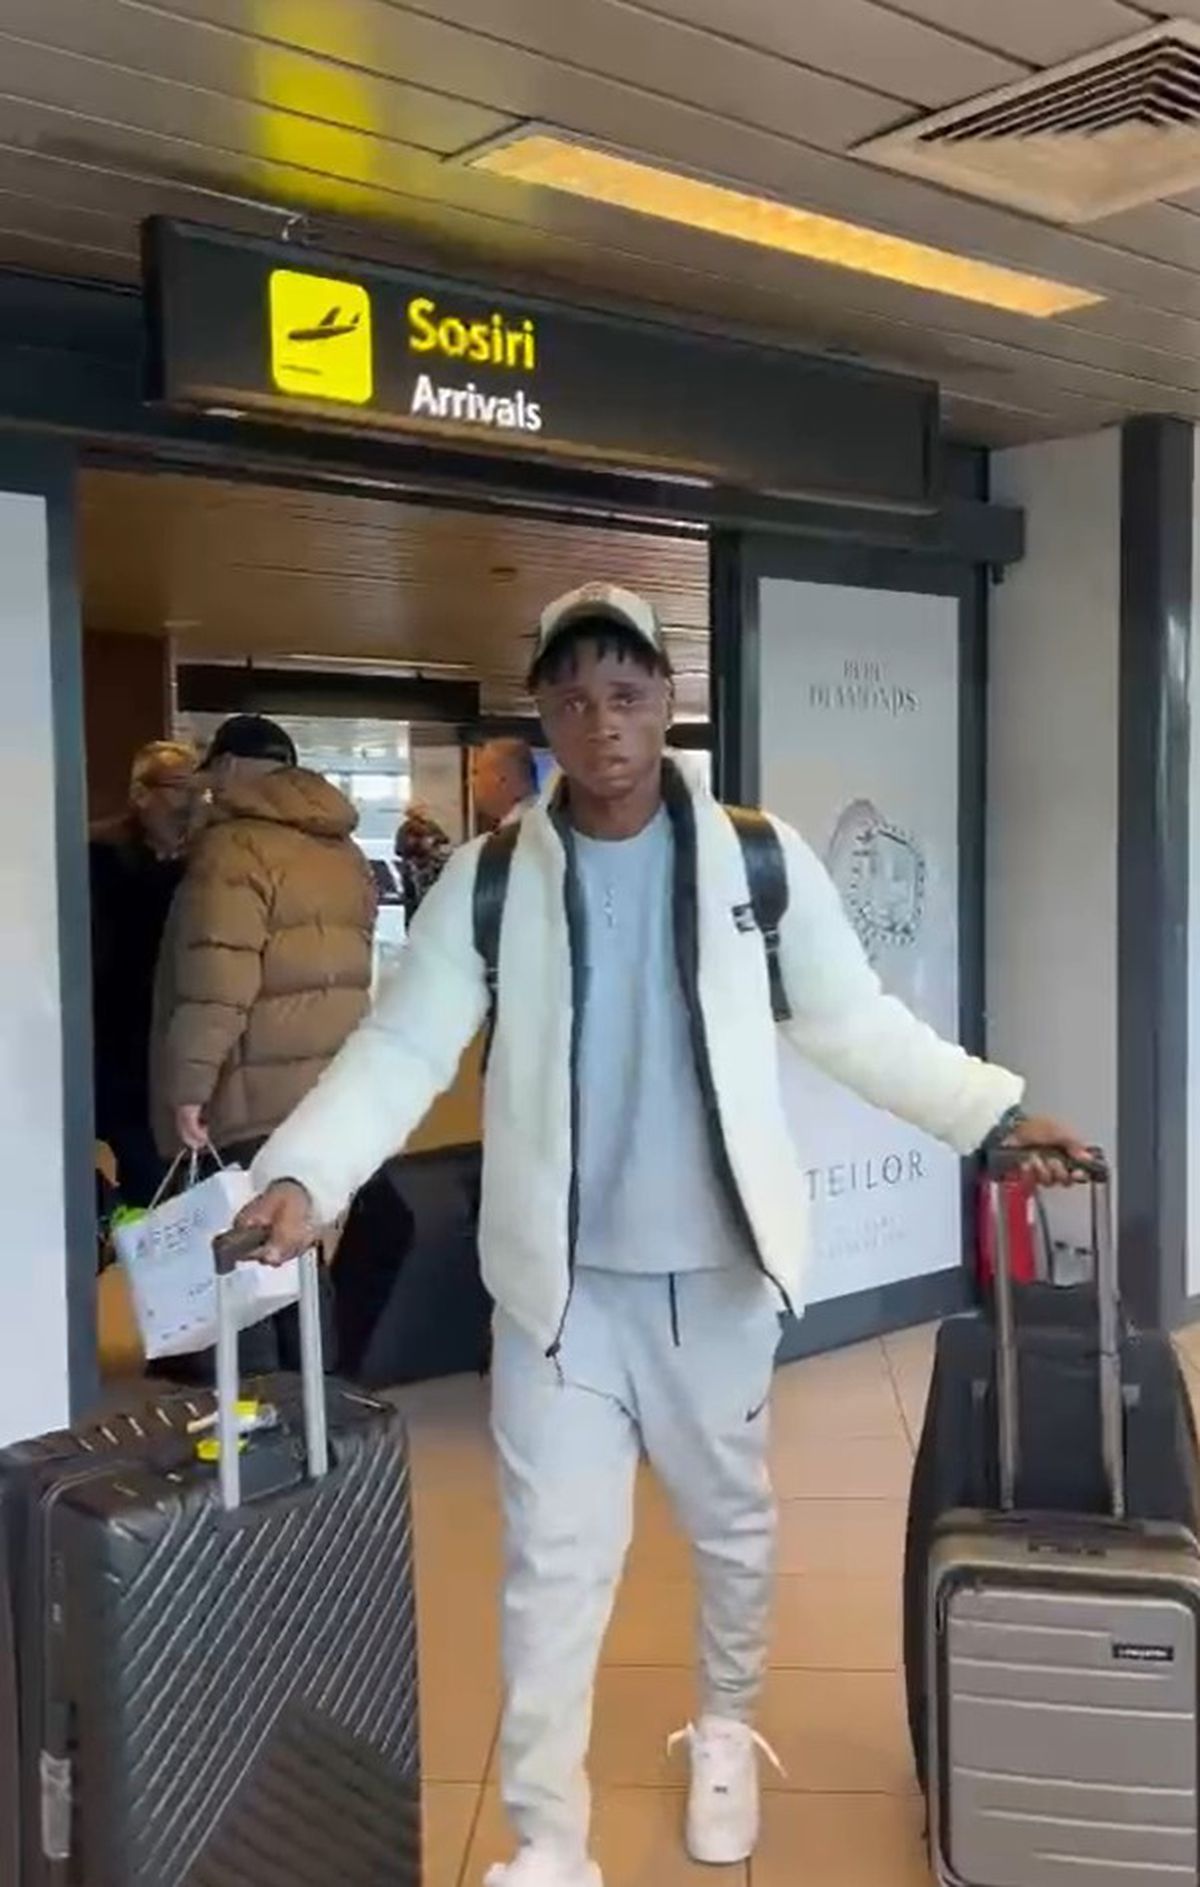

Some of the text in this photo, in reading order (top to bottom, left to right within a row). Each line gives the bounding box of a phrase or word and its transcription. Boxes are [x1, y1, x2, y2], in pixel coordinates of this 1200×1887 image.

[408, 297, 535, 369] Sosiri
[411, 374, 542, 430] Arrivals
[804, 1149, 925, 1201] TEILOR
